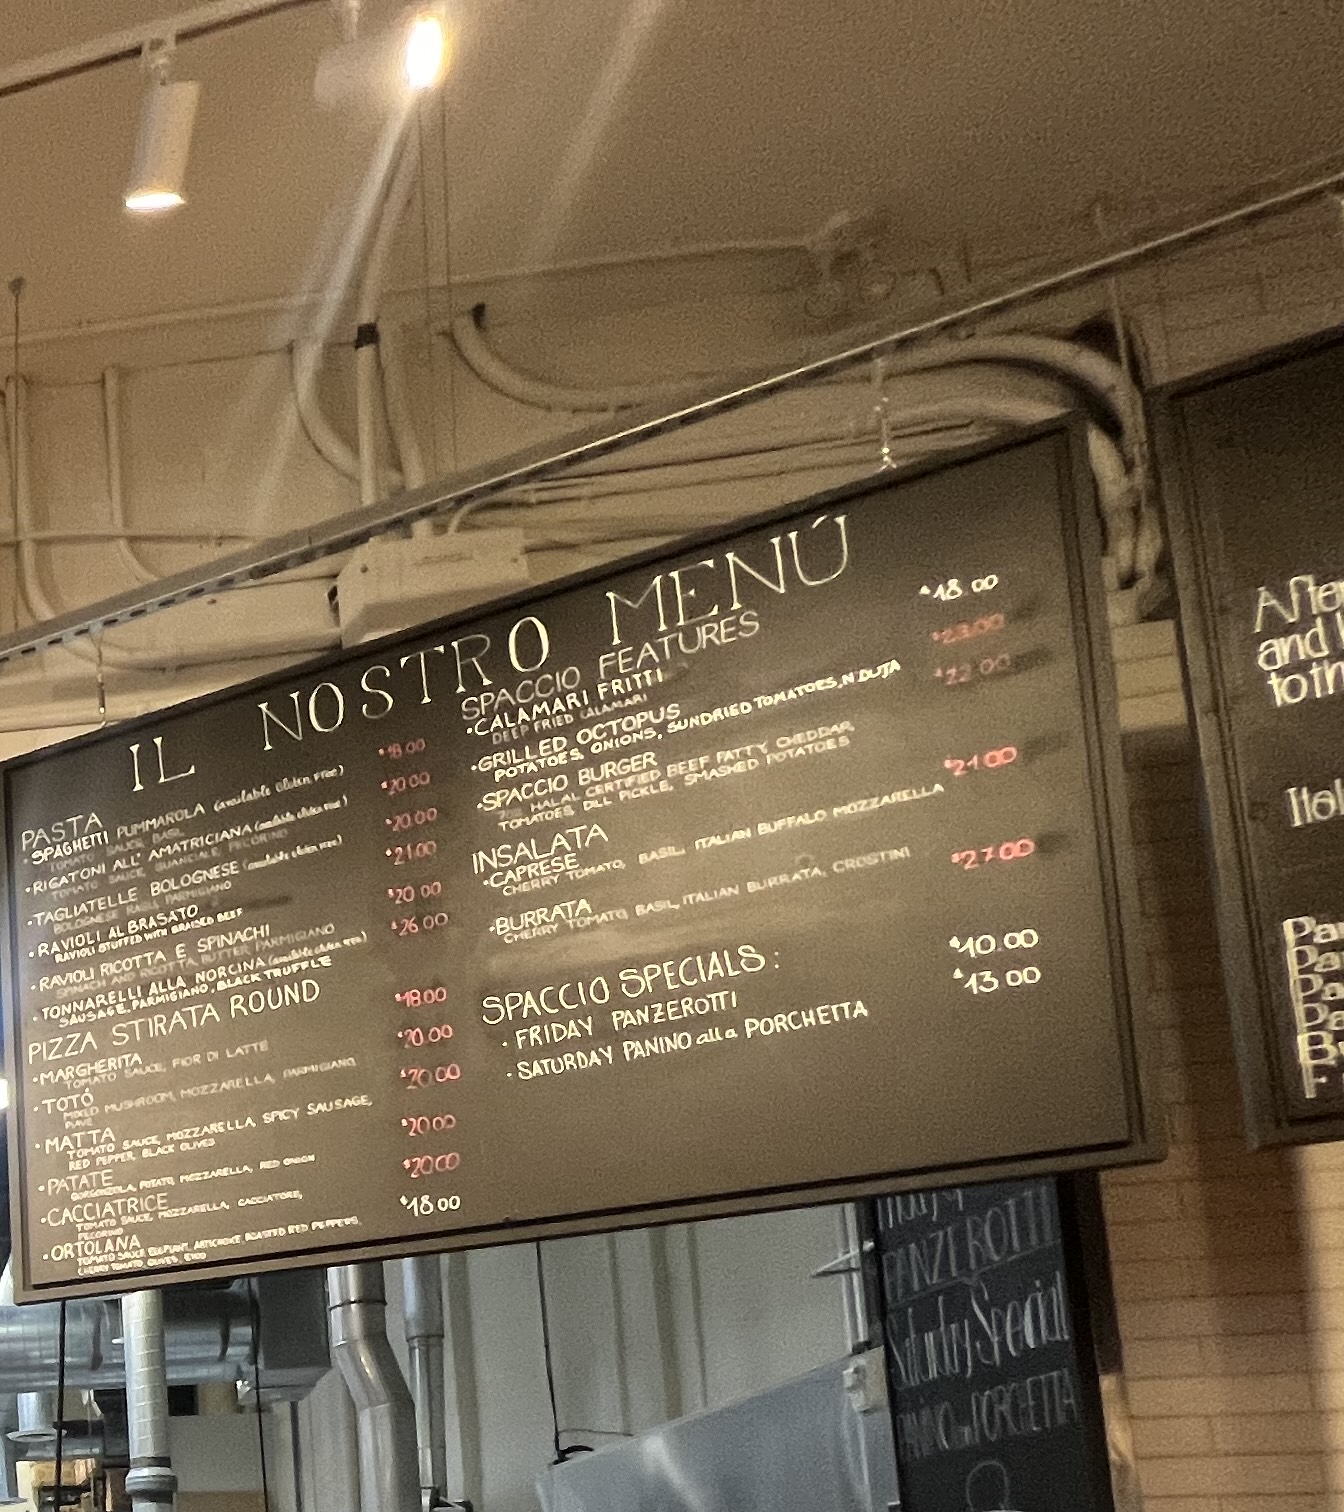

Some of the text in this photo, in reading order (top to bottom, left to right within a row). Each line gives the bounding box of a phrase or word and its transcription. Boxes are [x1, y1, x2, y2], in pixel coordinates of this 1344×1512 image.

[461, 610, 760, 721] SPACCIO FEATURES
[1258, 616, 1329, 671] and
[128, 735, 195, 791] IL
[258, 614, 550, 752] NOSTRO
[474, 669, 663, 736] CALAMARI FRITTI
[478, 704, 681, 773] GRILLED OCTOPUS
[481, 752, 658, 812] SPACCIO BURGER
[21, 812, 103, 850] PASTA
[471, 824, 608, 874] INSALATA
[488, 853, 579, 888] CAPRESE
[37, 904, 199, 956] RAVIOLI AL BRASATO
[495, 899, 591, 936] BURRATA
[29, 978, 321, 1060] PIZZA STIRATA ROUND
[482, 976, 610, 1026] SPACCIO
[515, 990, 738, 1050] FRIDAY PANZEROTTI
[517, 1001, 868, 1082] SATURDAY PANINO alla PORCHETTA
[40, 1053, 142, 1085] MARGHERITA
[45, 1127, 116, 1154] MATTA
[47, 1169, 113, 1196] PATATE
[48, 1193, 168, 1227] CACCIATRICE
[51, 1235, 141, 1262] ORTOLANA
